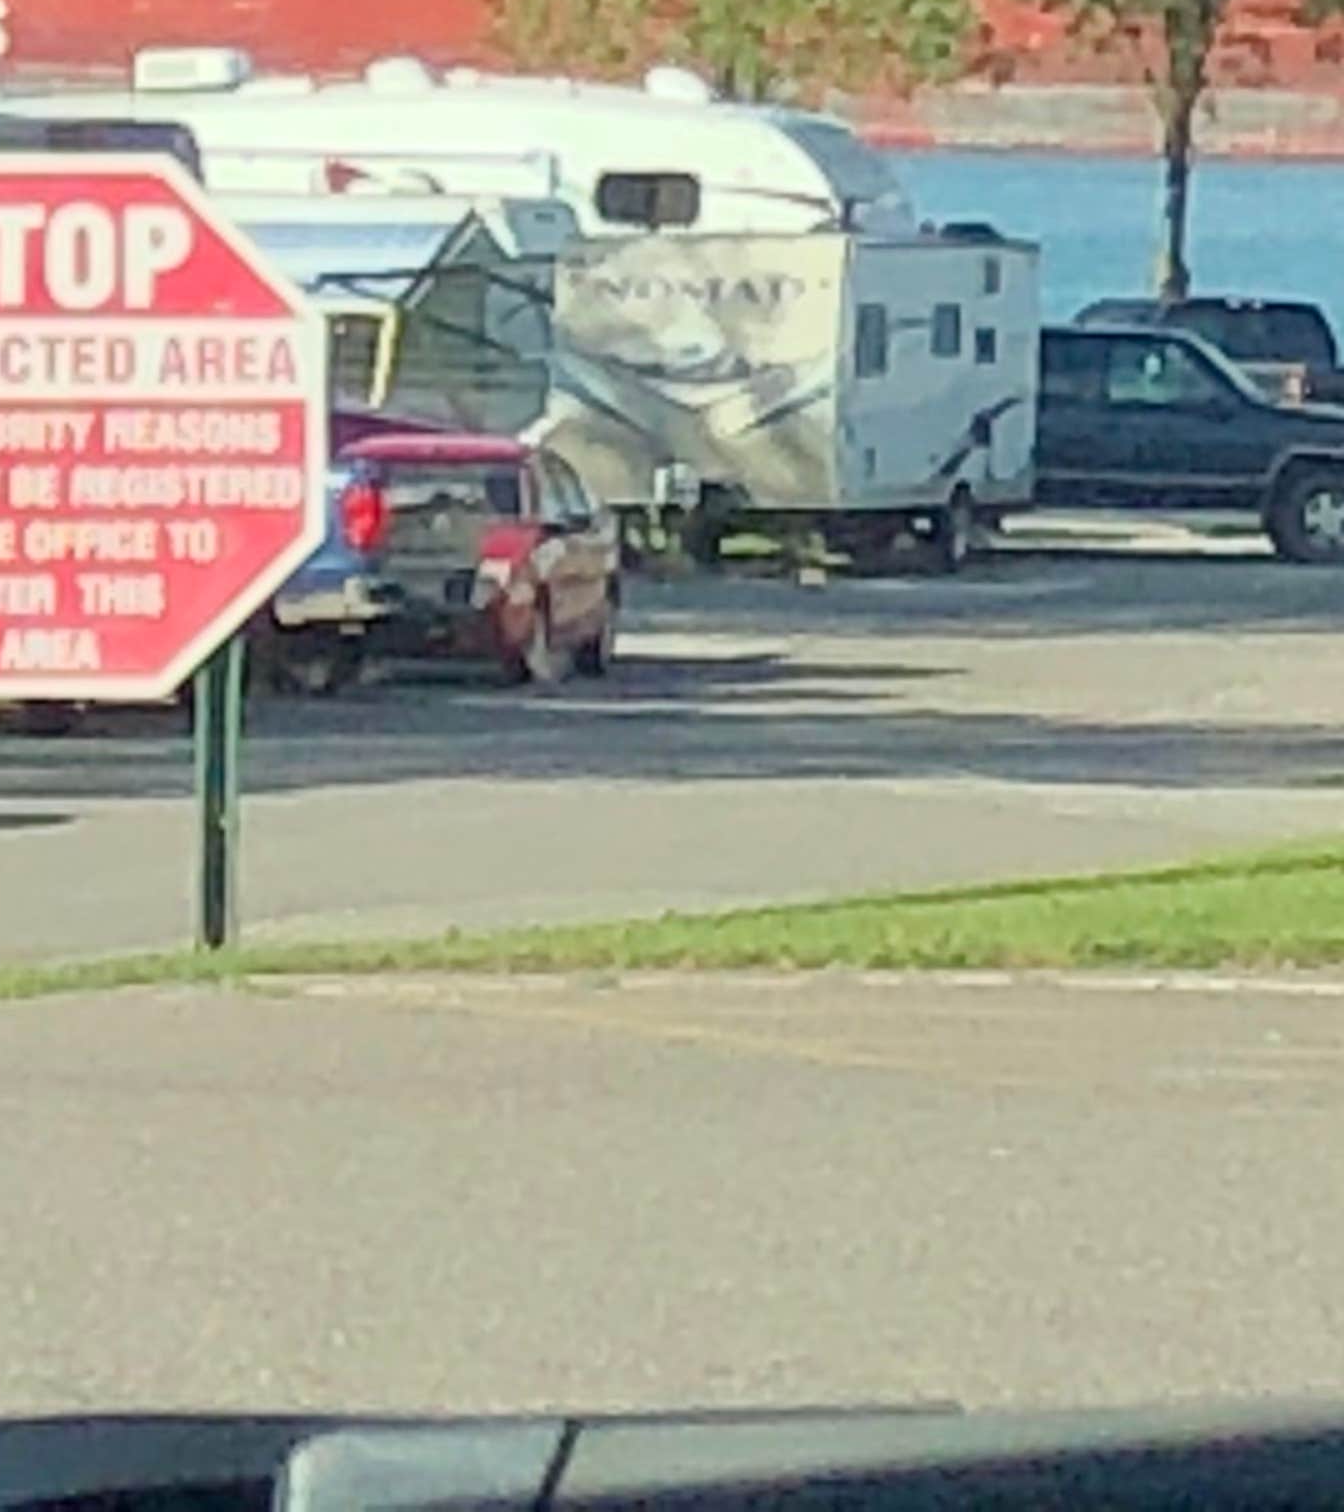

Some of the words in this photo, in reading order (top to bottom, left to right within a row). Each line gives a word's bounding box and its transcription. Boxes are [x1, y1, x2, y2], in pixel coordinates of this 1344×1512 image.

[158, 336, 297, 384] AREA
[104, 409, 281, 454] REASONS
[9, 465, 58, 508] BE
[70, 465, 301, 508] REGISTERED
[23, 519, 157, 562] OFFICE
[165, 519, 217, 562] TO
[75, 573, 165, 619] THIS
[0, 627, 101, 671] AREA
